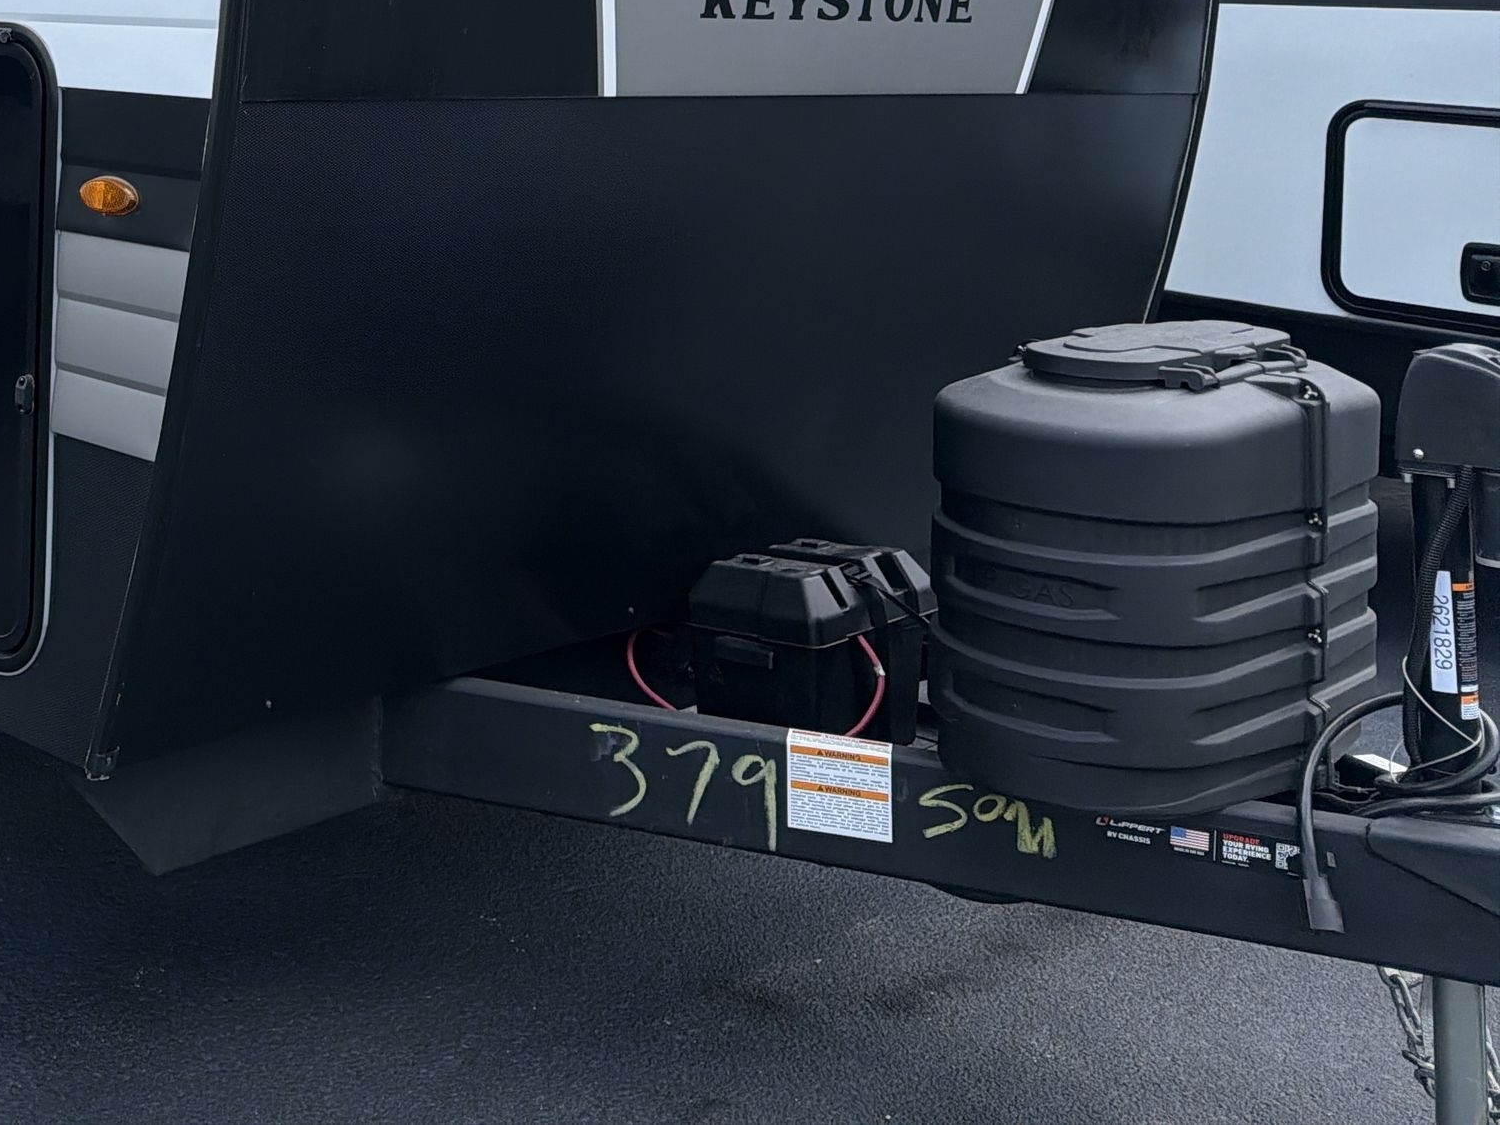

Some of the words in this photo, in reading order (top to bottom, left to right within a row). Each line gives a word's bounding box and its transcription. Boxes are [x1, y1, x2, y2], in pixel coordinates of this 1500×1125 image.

[1432, 594, 1454, 671] 2621829
[824, 750, 862, 762] WARNING
[589, 722, 778, 853] 379
[824, 785, 862, 797] WARNING
[1108, 818, 1166, 835] LIPPERT
[1106, 830, 1118, 839] RV
[1118, 832, 1151, 845] CHASSIS
[1222, 832, 1261, 845] UPGRADE
[1222, 839, 1244, 849] YOUR
[1245, 843, 1270, 853] RVING
[1222, 846, 1272, 861] EXPERIENCE
[1222, 853, 1251, 864] TODAY.
